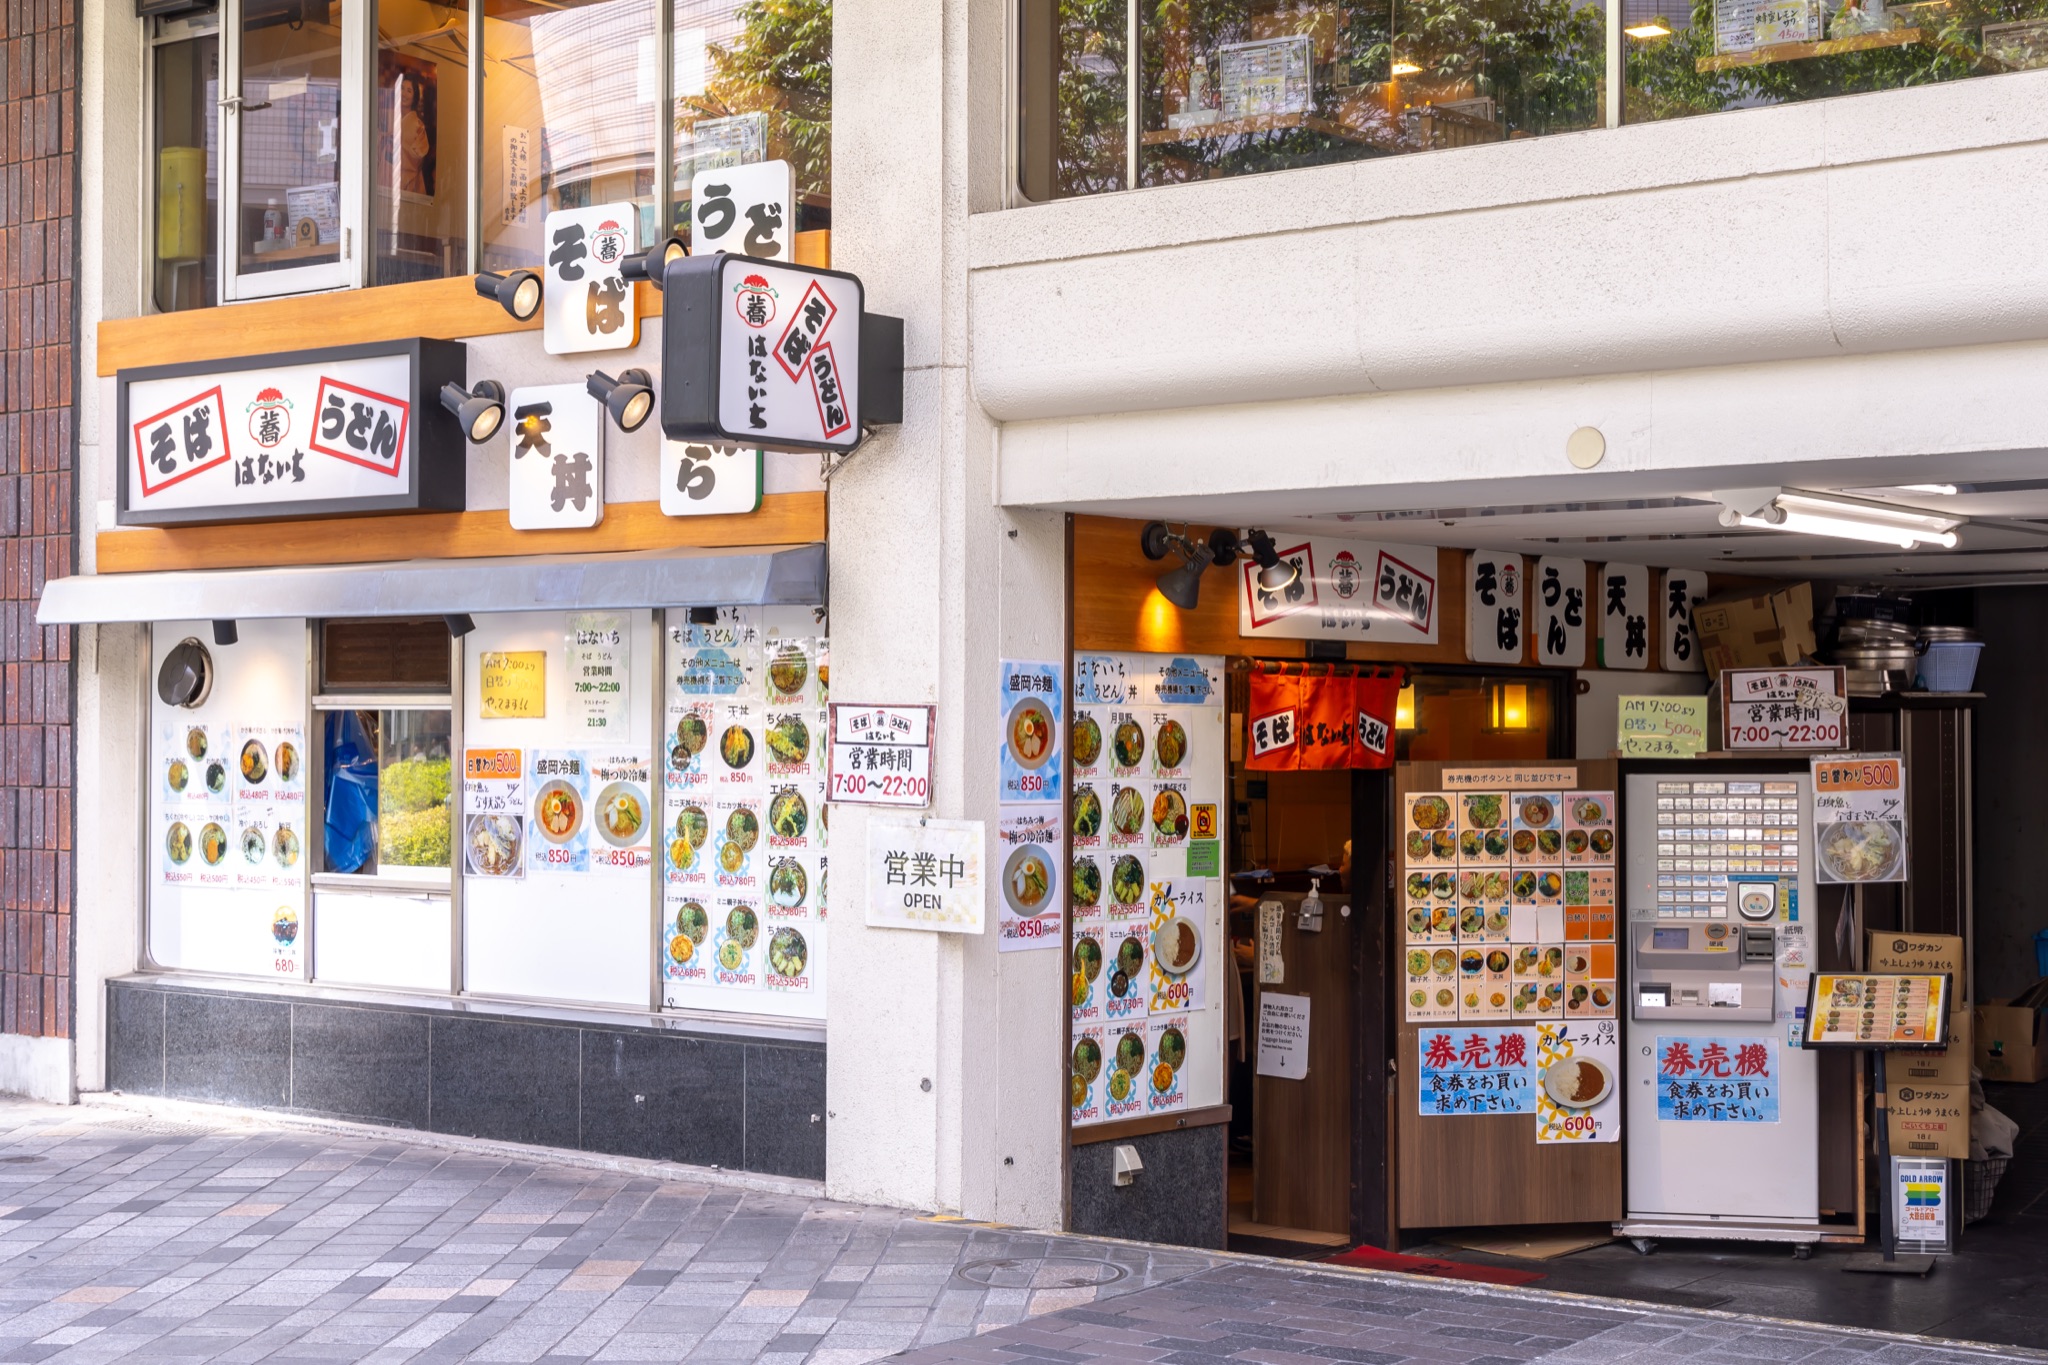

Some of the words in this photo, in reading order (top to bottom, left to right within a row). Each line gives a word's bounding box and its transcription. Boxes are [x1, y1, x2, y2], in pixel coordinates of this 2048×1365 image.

[697, 183, 782, 258] うど
[549, 222, 629, 335] そば
[745, 295, 766, 326] 蕎
[783, 296, 826, 366] そば
[748, 334, 768, 430] はないち
[814, 355, 846, 428] うどん
[259, 411, 281, 444] 蕎
[321, 393, 397, 460] うどん
[150, 405, 212, 475] そば
[515, 401, 593, 512] 天丼
[234, 448, 305, 487] はないち
[1380, 564, 1428, 621] うどん
[1475, 562, 1521, 651] そば
[1542, 566, 1583, 656] うどん
[1606, 575, 1647, 658] 天丼
[577, 630, 620, 645] はないち
[673, 630, 692, 643] そば
[704, 630, 733, 643] うどん
[743, 629, 755, 643] 丼
[582, 652, 592, 660] そば
[597, 652, 612, 660] うどん
[680, 658, 741, 668] その他メニューは
[485, 659, 501, 669] AM
[583, 666, 613, 677] 営業時間
[1077, 661, 1125, 678] はないち
[1158, 666, 1209, 678] その他メニューは
[575, 682, 621, 692] 7:00〜22:00
[1094, 684, 1120, 699] うどん
[1128, 686, 1137, 699] 丼
[1751, 680, 1769, 690] そば
[1624, 700, 1645, 712] AM
[1649, 699, 1695, 716] 7:00より
[1804, 695, 1843, 713] 21:30
[767, 712, 801, 724] ちくわ天
[1110, 712, 1133, 724] 月見野
[1747, 703, 1820, 722] 営業時間
[587, 717, 607, 727] 21:30
[852, 715, 868, 730] そば
[891, 718, 911, 732] うどん
[1624, 718, 1657, 731] 日替り
[1664, 717, 1702, 737] 500円
[865, 731, 896, 742] はないち
[1255, 714, 1291, 749] そば
[1358, 718, 1386, 750] うどん
[1731, 725, 1839, 742] 7:00〜22:00
[848, 747, 912, 772] 営業時間
[768, 763, 810, 775] 税込550円
[668, 773, 708, 784] 税込730円
[719, 772, 753, 783] 税込850円
[834, 773, 927, 797] 7:00〜22:00
[1007, 774, 1049, 791] 税込850円
[240, 790, 268, 800] 税込480円
[275, 790, 304, 801] 税込480円
[770, 784, 798, 795] エビ天
[1111, 784, 1120, 797] 肉
[1017, 815, 1045, 825] はちみつ梅
[769, 836, 807, 848] 税込580円
[1111, 833, 1144, 845] 税込580円
[767, 854, 798, 868] とろろ
[884, 849, 965, 889] 営業中
[670, 872, 706, 884] 税込780円
[719, 874, 755, 887] 税込780円
[904, 892, 942, 910] OPEN
[1154, 891, 1204, 906] カレーライス
[1110, 902, 1145, 915] 税込550円
[1784, 925, 1804, 935] 紙幣
[1909, 943, 1943, 953] ワダカン
[1880, 958, 1925, 968] 吟上しょうゆ
[1928, 960, 1953, 970] うまくち
[670, 966, 706, 979] 税込680円
[719, 971, 755, 985] 税込700円
[767, 974, 808, 989] 税込550円
[1157, 982, 1194, 1000] 税込600円
[1108, 998, 1144, 1011] 税込730円
[1542, 1033, 1616, 1048] カレーライス
[1424, 1033, 1528, 1070] 券売機
[1662, 1042, 1770, 1078] 券売機
[1428, 1073, 1527, 1091] 食券をお買い
[1666, 1081, 1770, 1100] 食券をお買い
[1916, 1090, 1950, 1101] ワダカン
[1110, 1100, 1141, 1114] 税込700円
[1152, 1093, 1184, 1106] 税込680円
[1436, 1092, 1522, 1112] 求め下さい。
[1673, 1101, 1764, 1120] 求め下さい。
[1888, 1106, 1932, 1117] 吟上しょうゆ
[1935, 1107, 1961, 1118] うまくち
[1548, 1115, 1602, 1133] 税込600円
[1900, 1175, 1917, 1183] GOLD
[1919, 1175, 1943, 1183] ARROW
